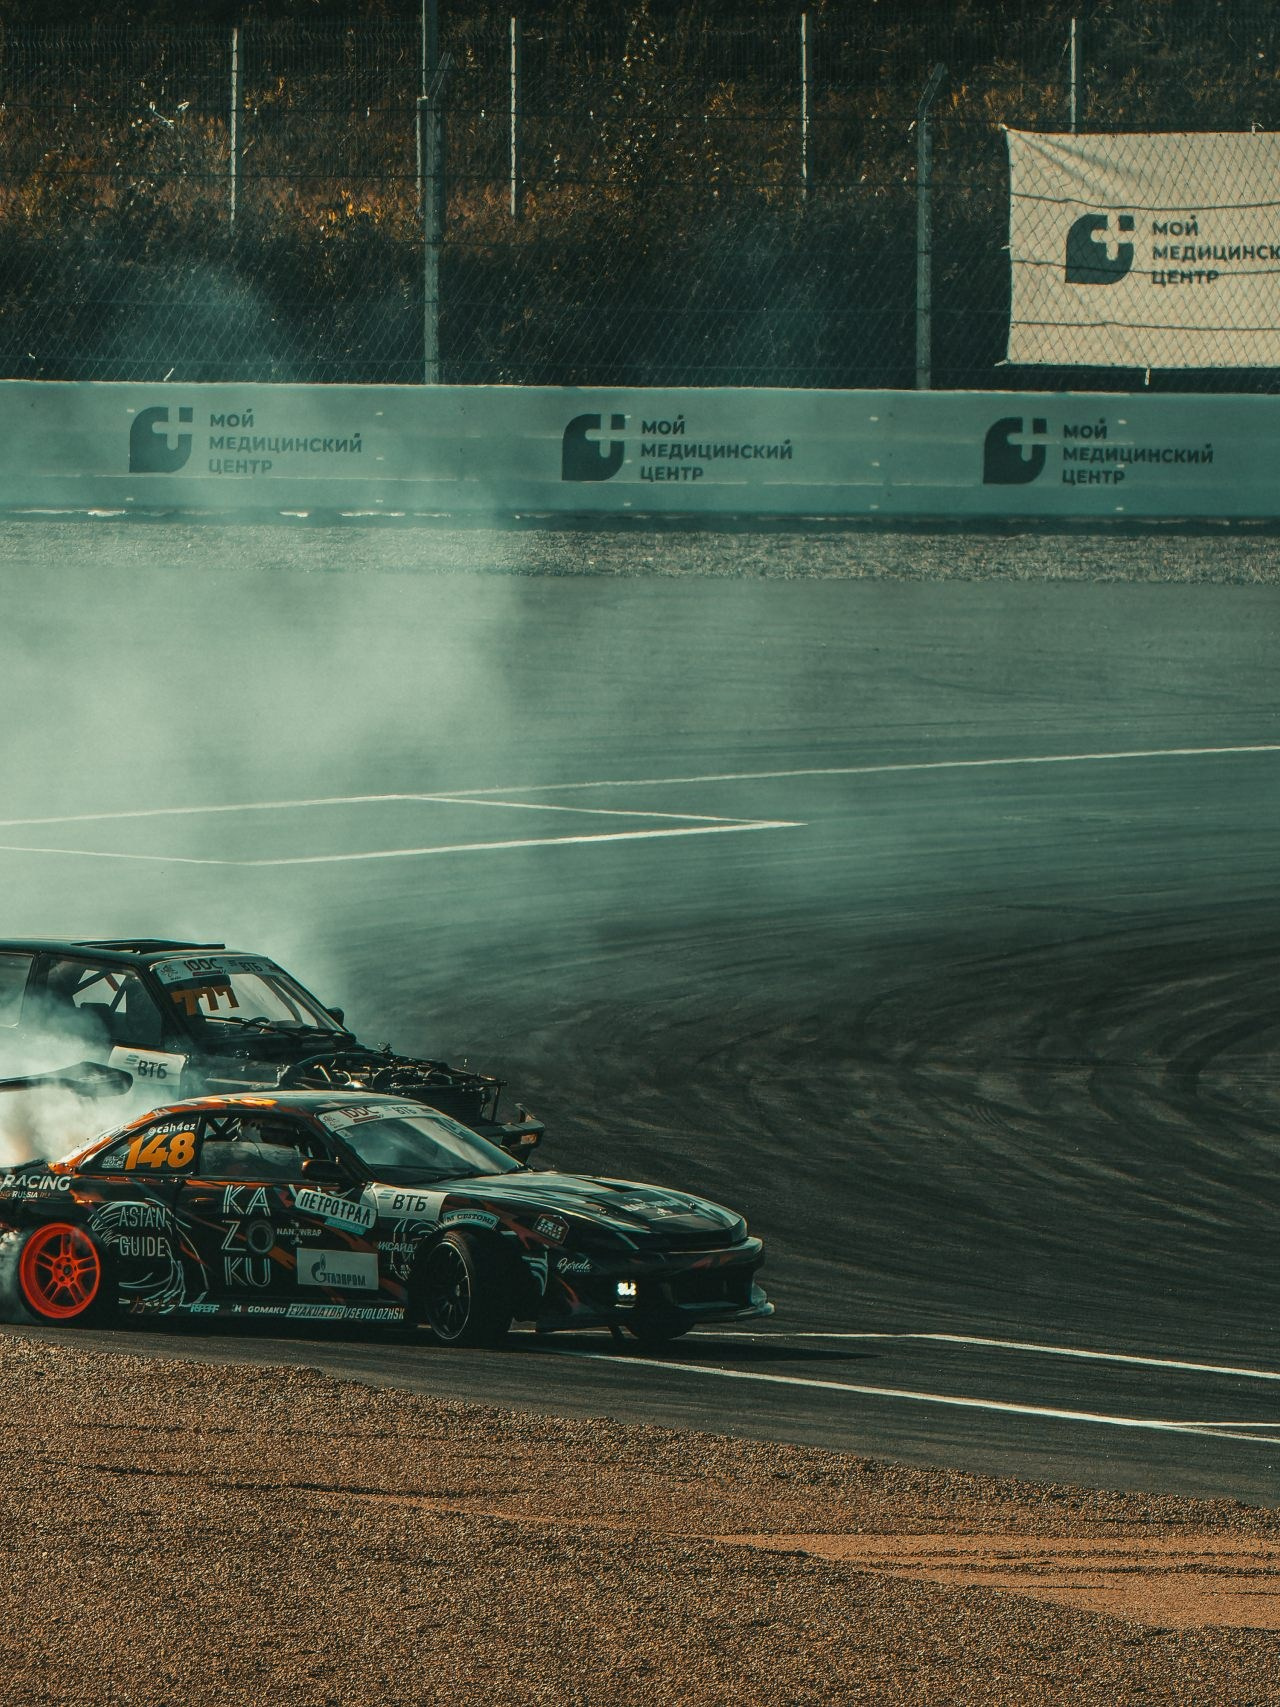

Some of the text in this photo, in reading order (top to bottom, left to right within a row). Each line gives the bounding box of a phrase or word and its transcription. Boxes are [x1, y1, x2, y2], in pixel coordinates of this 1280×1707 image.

[1152, 214, 1199, 236] МОЙ
[1152, 270, 1220, 287] ЦЕНТР
[210, 408, 255, 428] МОЙ
[642, 414, 686, 435] МОЙ
[1063, 417, 1108, 439] МОЙ
[209, 432, 362, 454] МЕДИЦИНСКИЙ
[640, 439, 793, 460] МЕДИЦИНСКИЙ
[1062, 443, 1214, 464] МЕДИЦИНСКИЙ
[208, 459, 273, 475] ЦЕНТР
[640, 465, 704, 482] ЦЕНТР
[1062, 469, 1125, 486] ЦЕНТР
[170, 985, 240, 1016] 777
[137, 1060, 168, 1079] ВТБ
[125, 1132, 195, 1170] 148
[223, 1184, 271, 1216] KA
[300, 1192, 371, 1226] ПЕТРОТРАЛ
[392, 1193, 428, 1212] ВТБ
[118, 1206, 166, 1227] ASIAN
[119, 1236, 166, 1257] GUIDE
[221, 1219, 274, 1254] ZO
[224, 1256, 271, 1287] KU
[247, 1306, 286, 1315] GOMAKU
